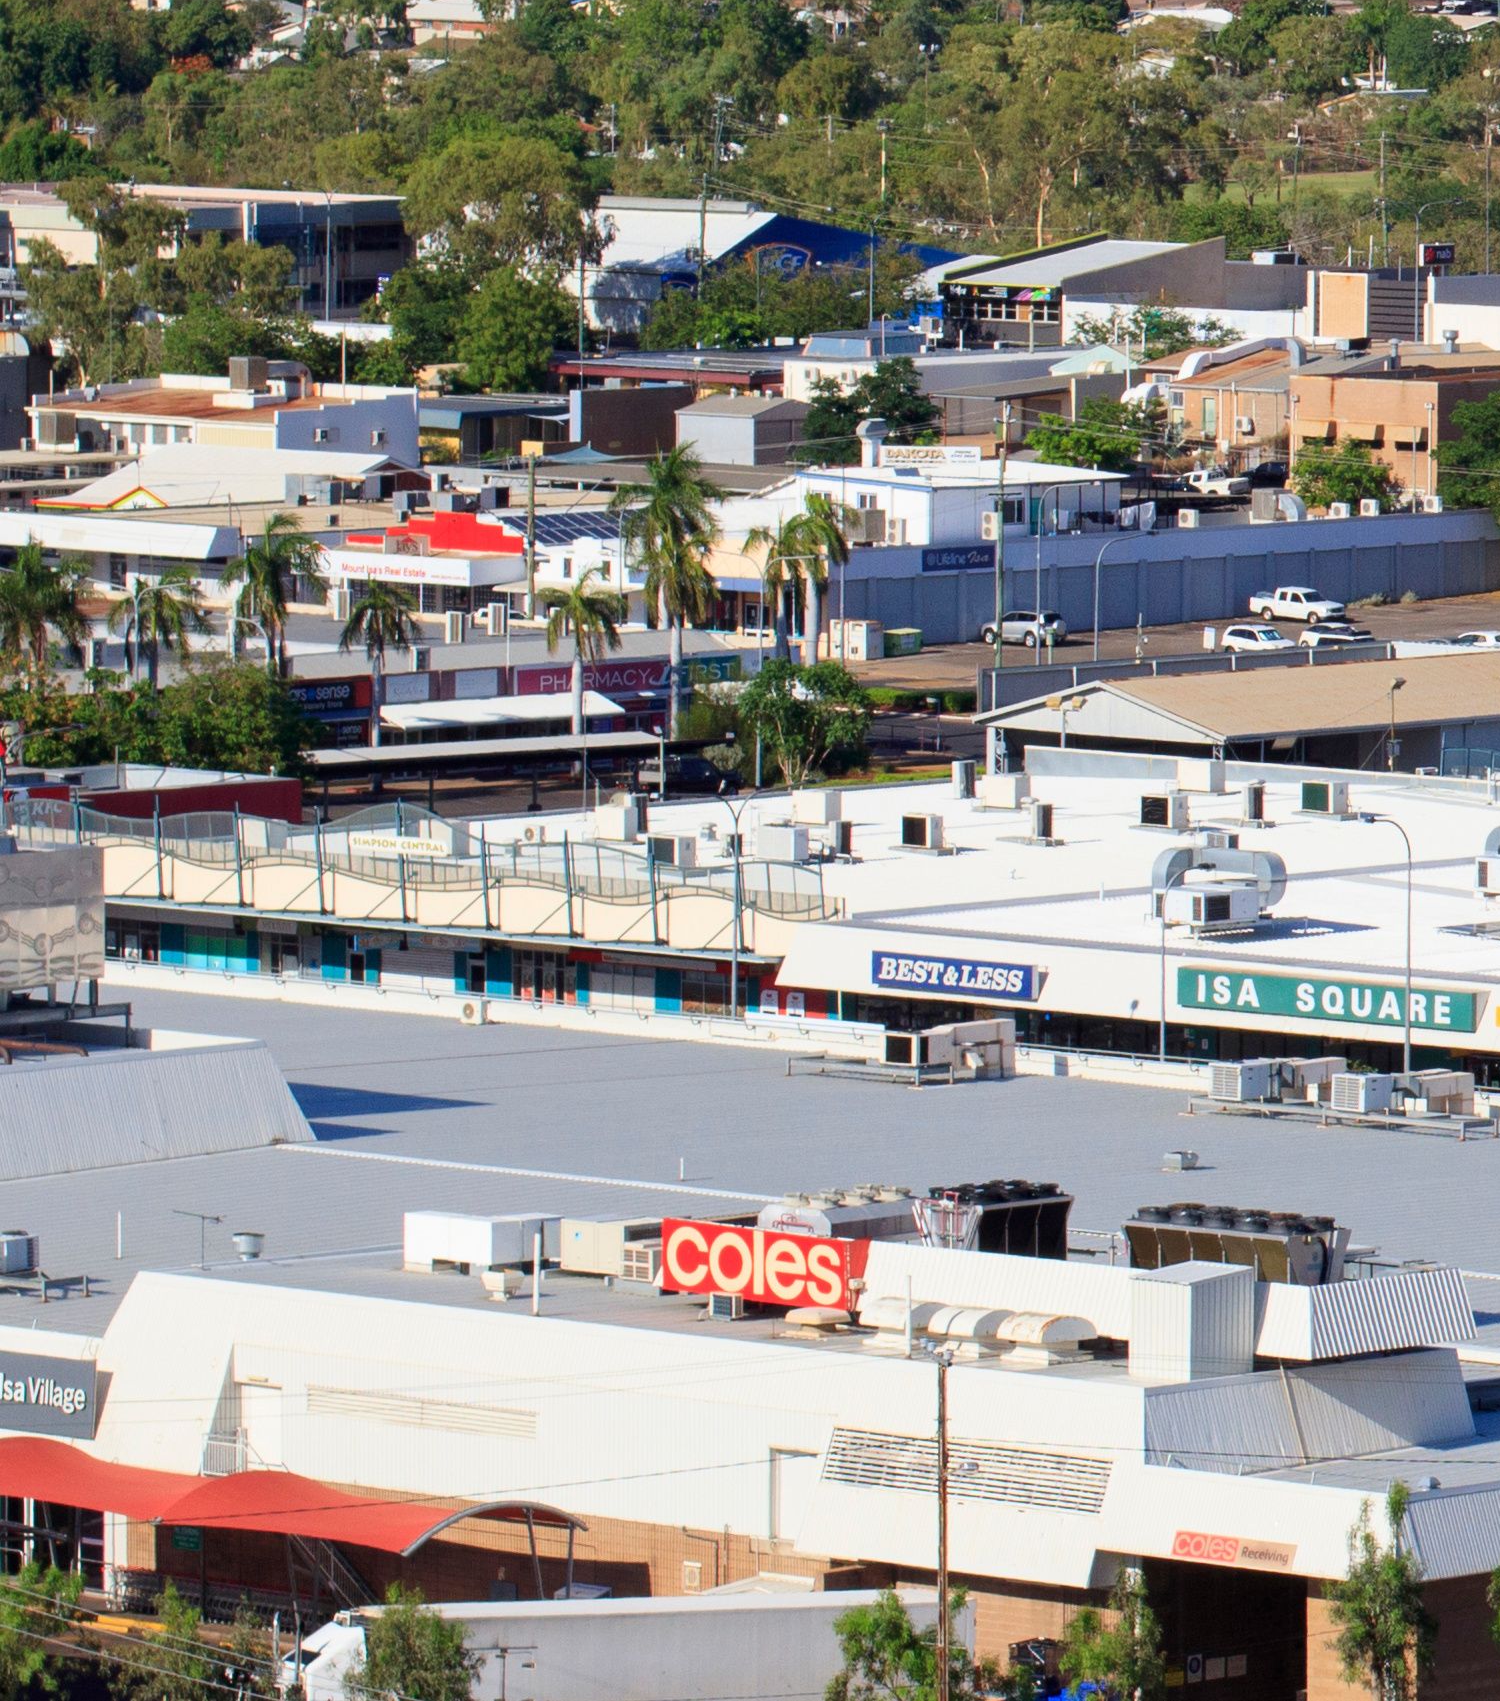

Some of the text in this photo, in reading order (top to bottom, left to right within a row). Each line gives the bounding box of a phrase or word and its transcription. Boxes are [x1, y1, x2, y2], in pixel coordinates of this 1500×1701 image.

[1436, 250, 1453, 259] nab
[886, 448, 948, 460] DAKOTA
[341, 563, 365, 573] Mount
[384, 566, 401, 576] Real
[403, 567, 427, 578] Estate
[315, 684, 351, 700] sense
[353, 837, 446, 854] SIMPSON CENTRAL
[879, 957, 1025, 994] BEST&LESS
[1196, 973, 1453, 1026] ISA SQUARE
[667, 1225, 845, 1307] coles
[28, 1376, 87, 1415] Village
[1174, 1535, 1290, 1563] coles Receiving
